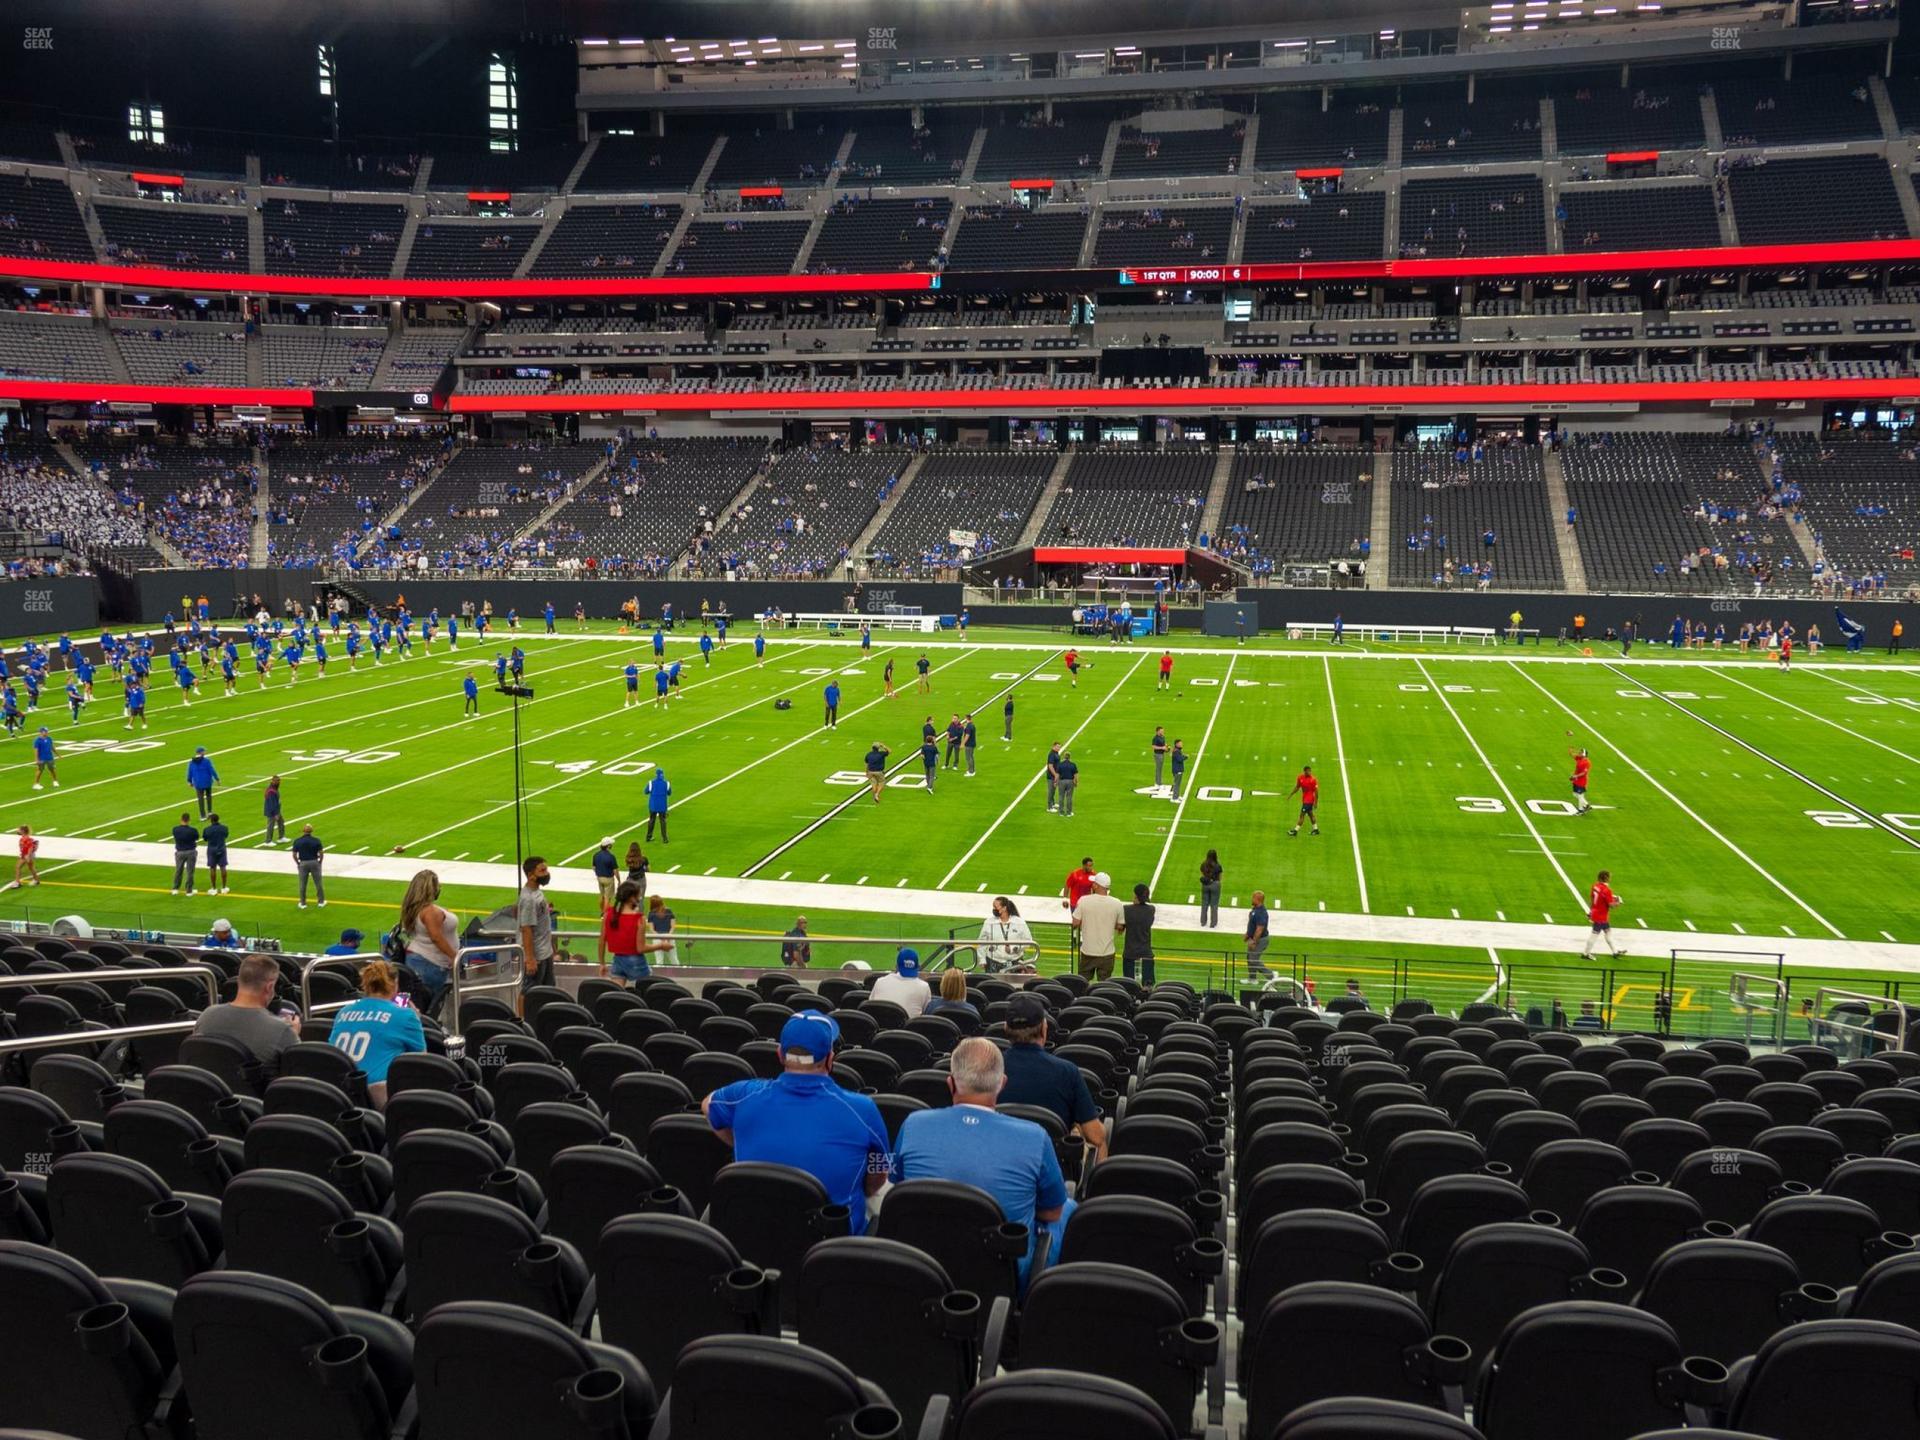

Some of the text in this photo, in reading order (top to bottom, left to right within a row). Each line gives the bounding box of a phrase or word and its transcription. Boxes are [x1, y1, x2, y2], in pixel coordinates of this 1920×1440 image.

[1143, 272, 1176, 280] 1ST QTR
[1190, 270, 1219, 279] 90:00
[1233, 270, 1240, 278] 6
[415, 395, 427, 403] CC
[338, 1009, 392, 1024] MULLIS
[335, 1030, 371, 1062] 00
